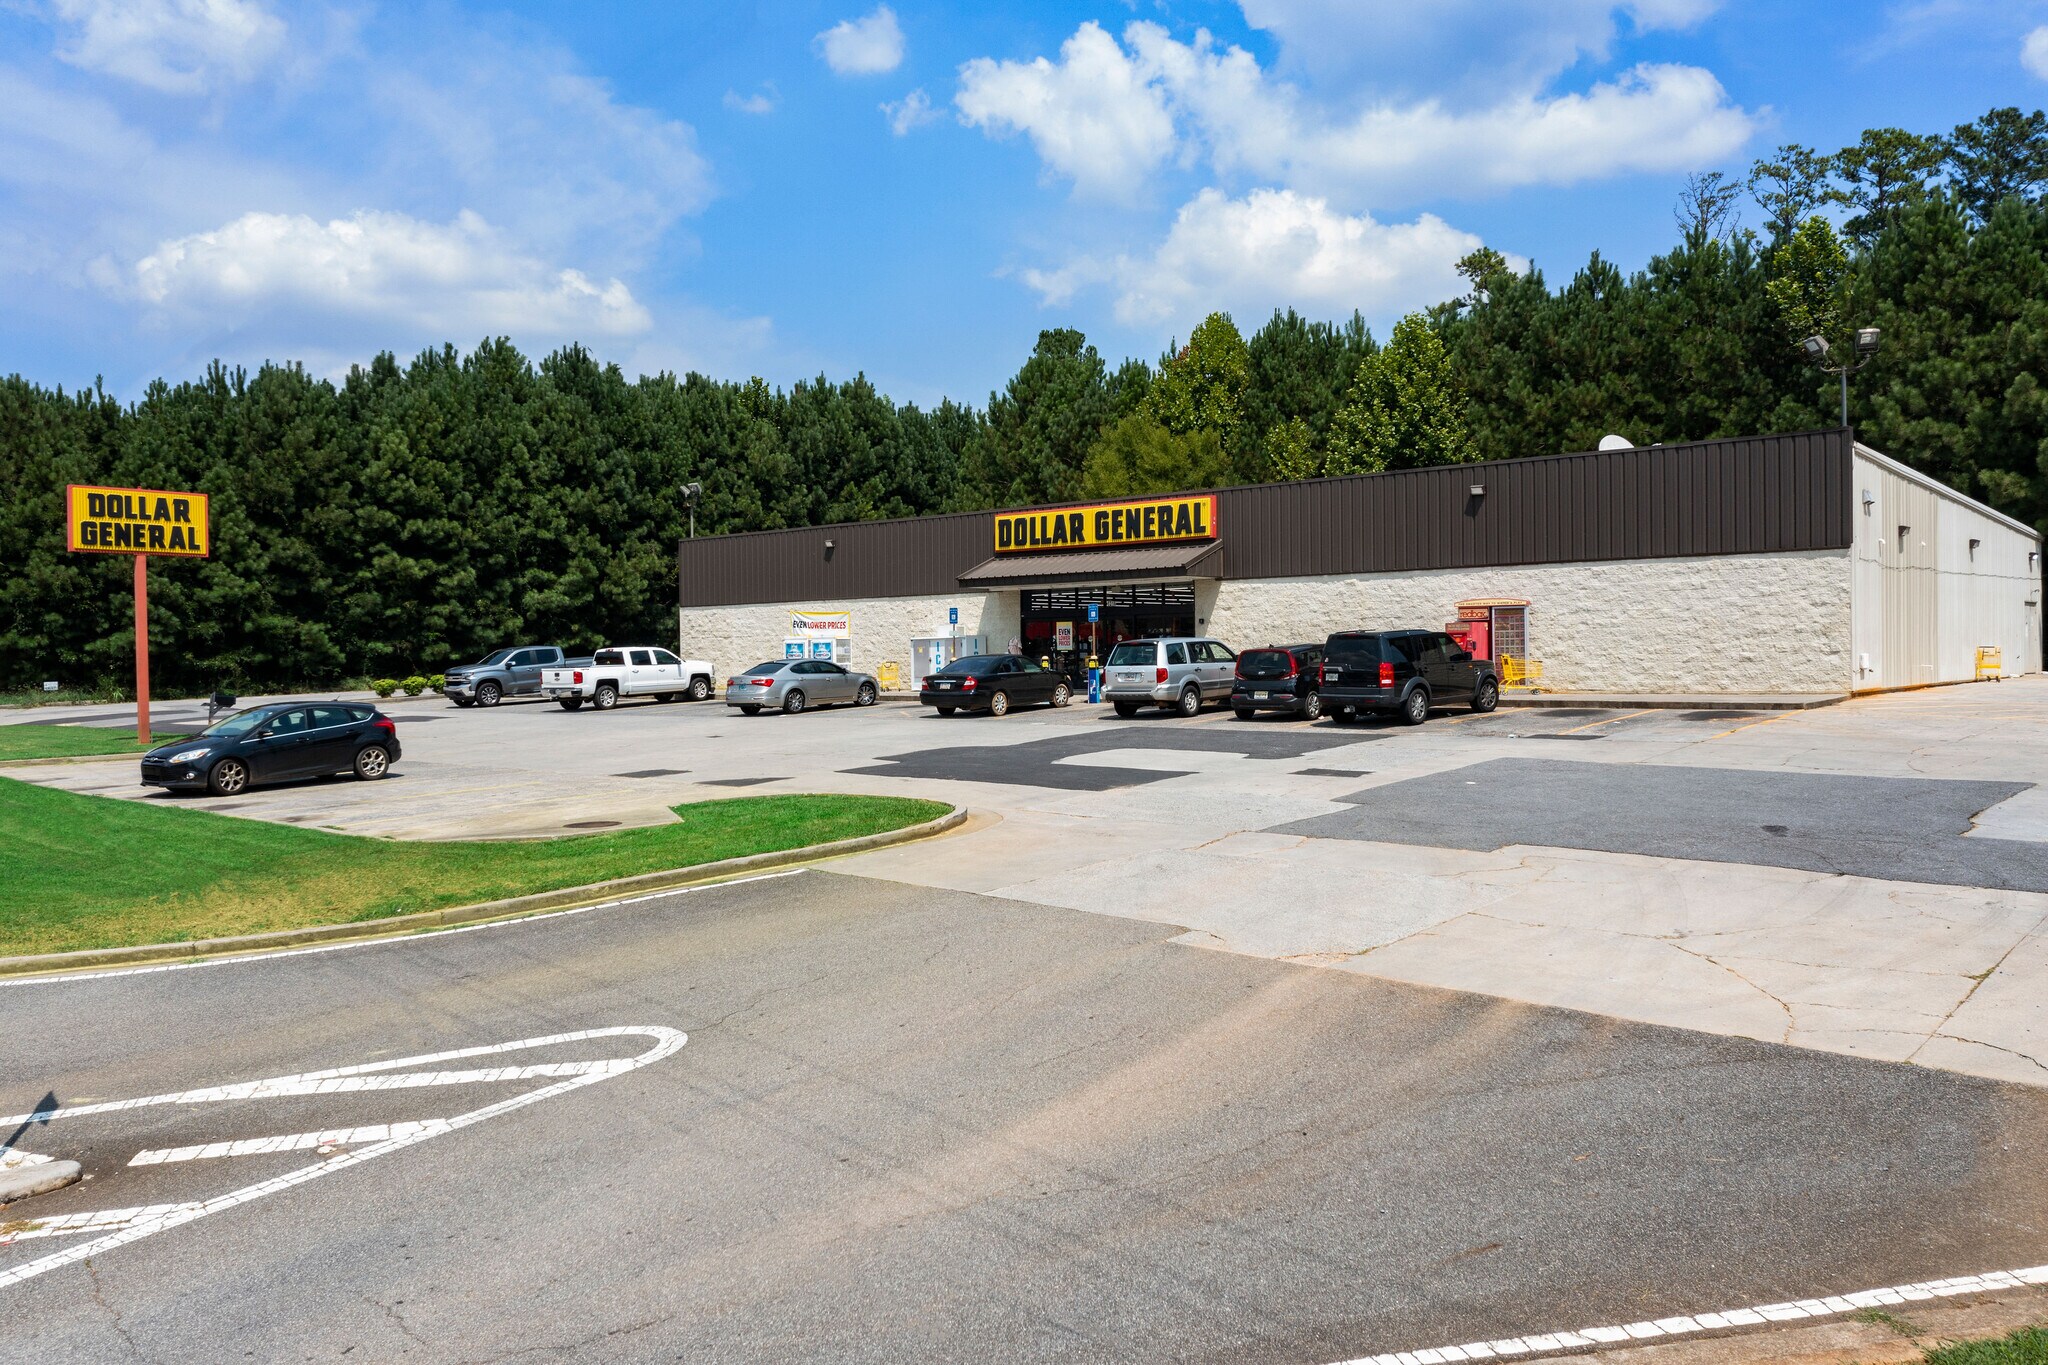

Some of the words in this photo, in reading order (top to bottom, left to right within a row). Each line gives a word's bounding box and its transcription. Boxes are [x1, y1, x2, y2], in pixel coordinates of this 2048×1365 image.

[88, 493, 191, 522] DOLLAR
[80, 521, 200, 550] GENERAL
[998, 513, 1085, 547] DOLLAR
[1094, 502, 1207, 540] GENERAL
[793, 620, 807, 629] EVEN
[807, 621, 826, 629] LOWER
[827, 621, 846, 629] PRICES
[1460, 610, 1487, 618] redbox
